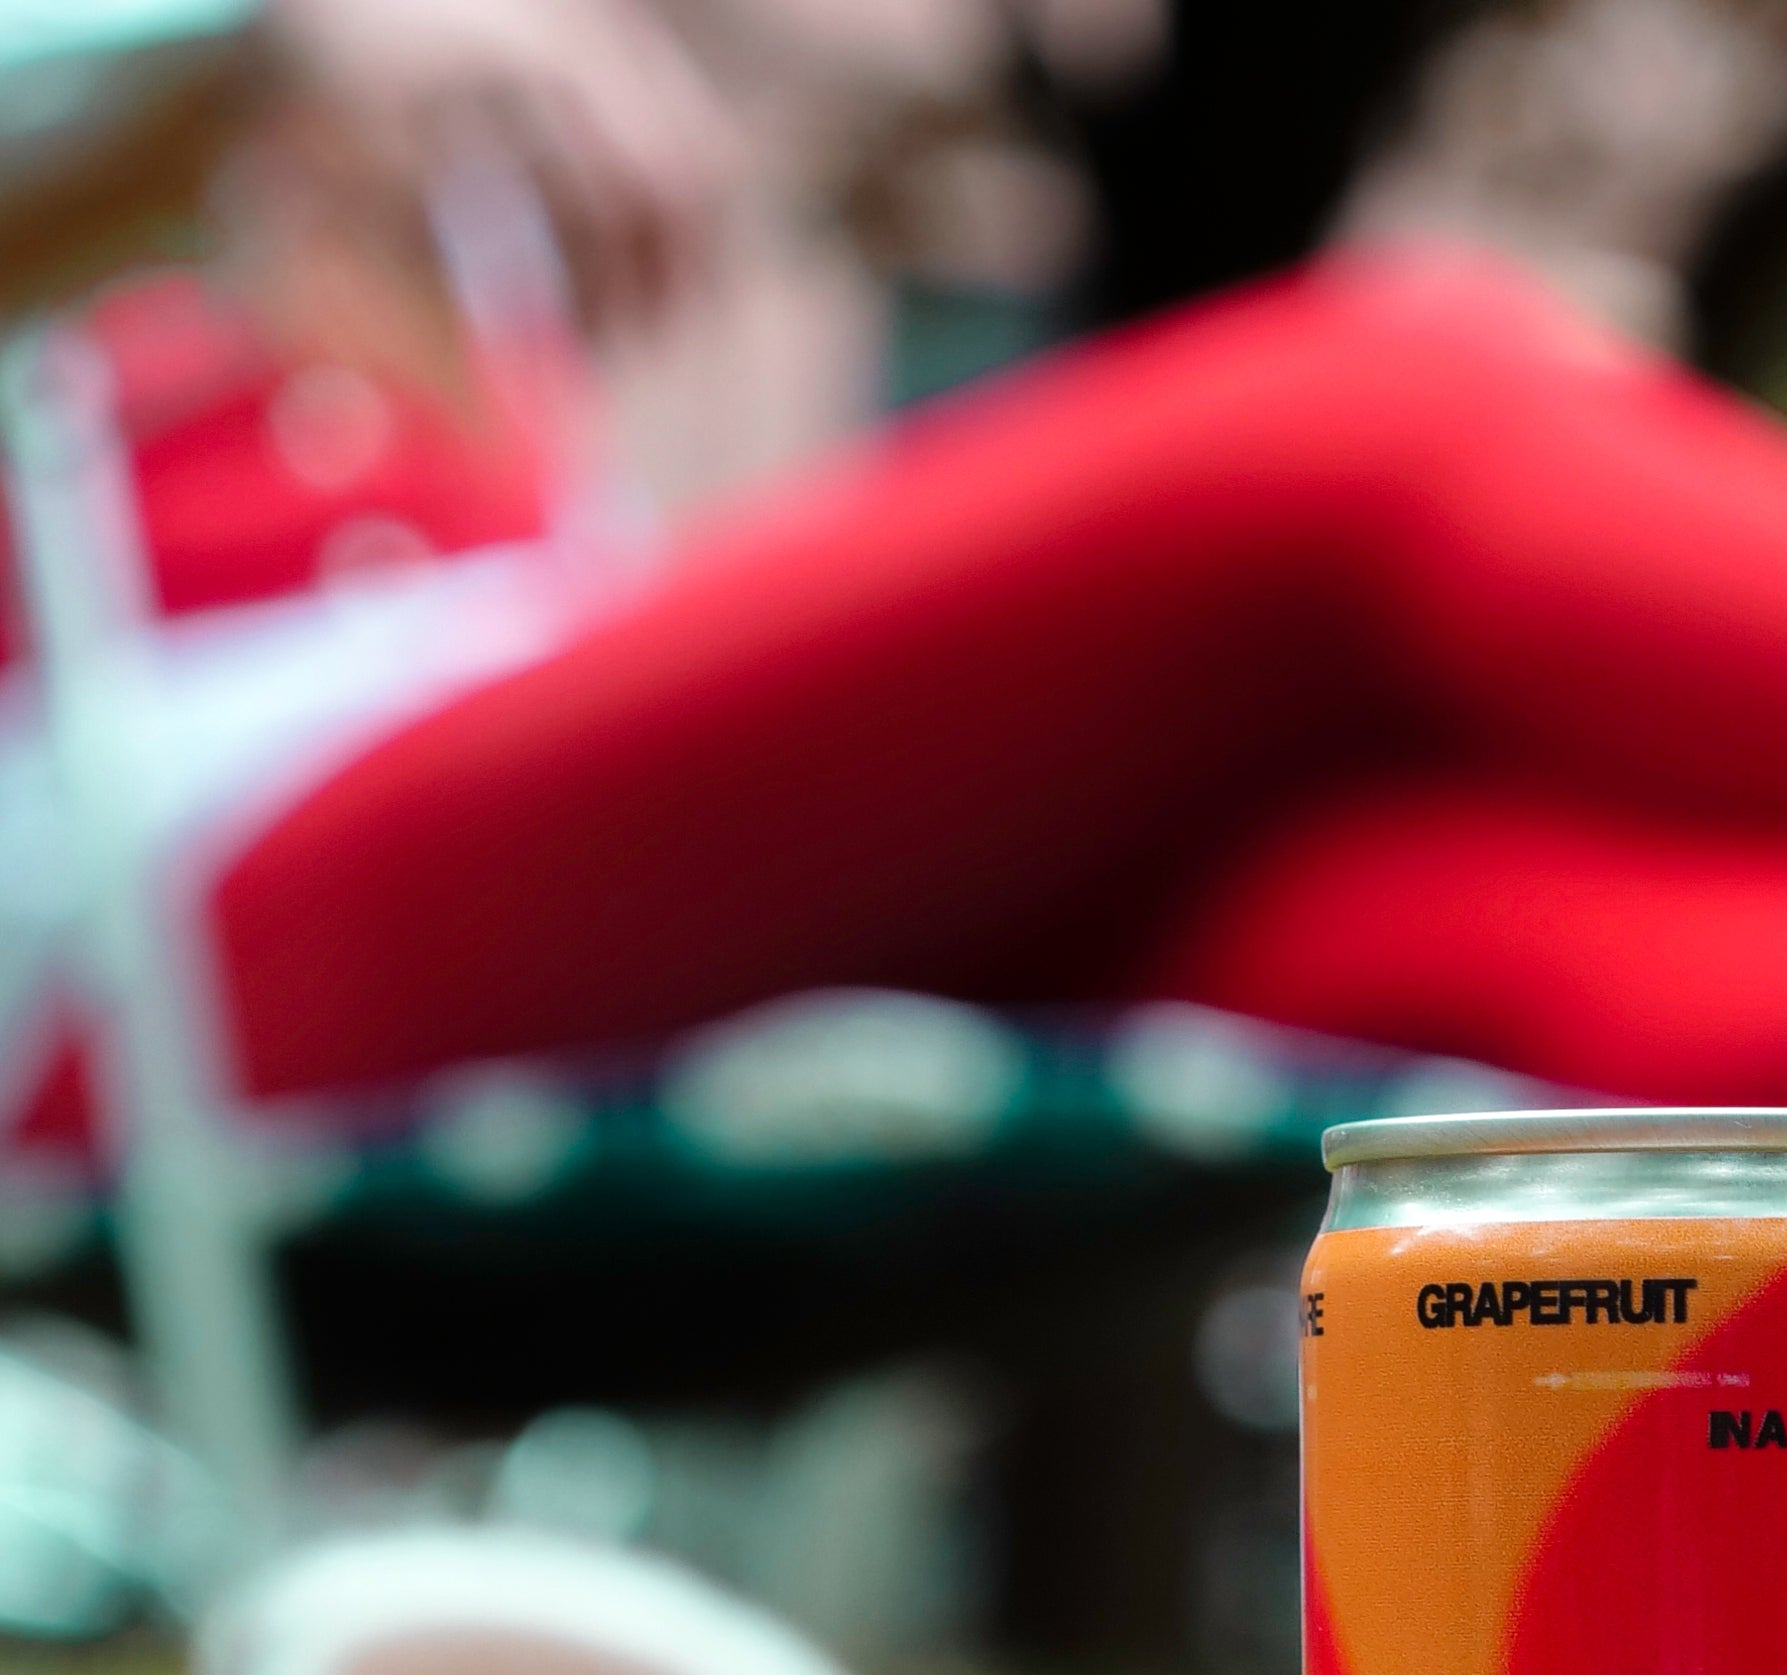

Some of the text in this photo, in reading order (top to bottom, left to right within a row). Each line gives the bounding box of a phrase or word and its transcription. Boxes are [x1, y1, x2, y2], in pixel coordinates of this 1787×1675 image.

[1417, 1278, 1697, 1328] GRAPEFRUIT
[1708, 1412, 1750, 1449] IN
[1755, 1411, 1787, 1448] A
